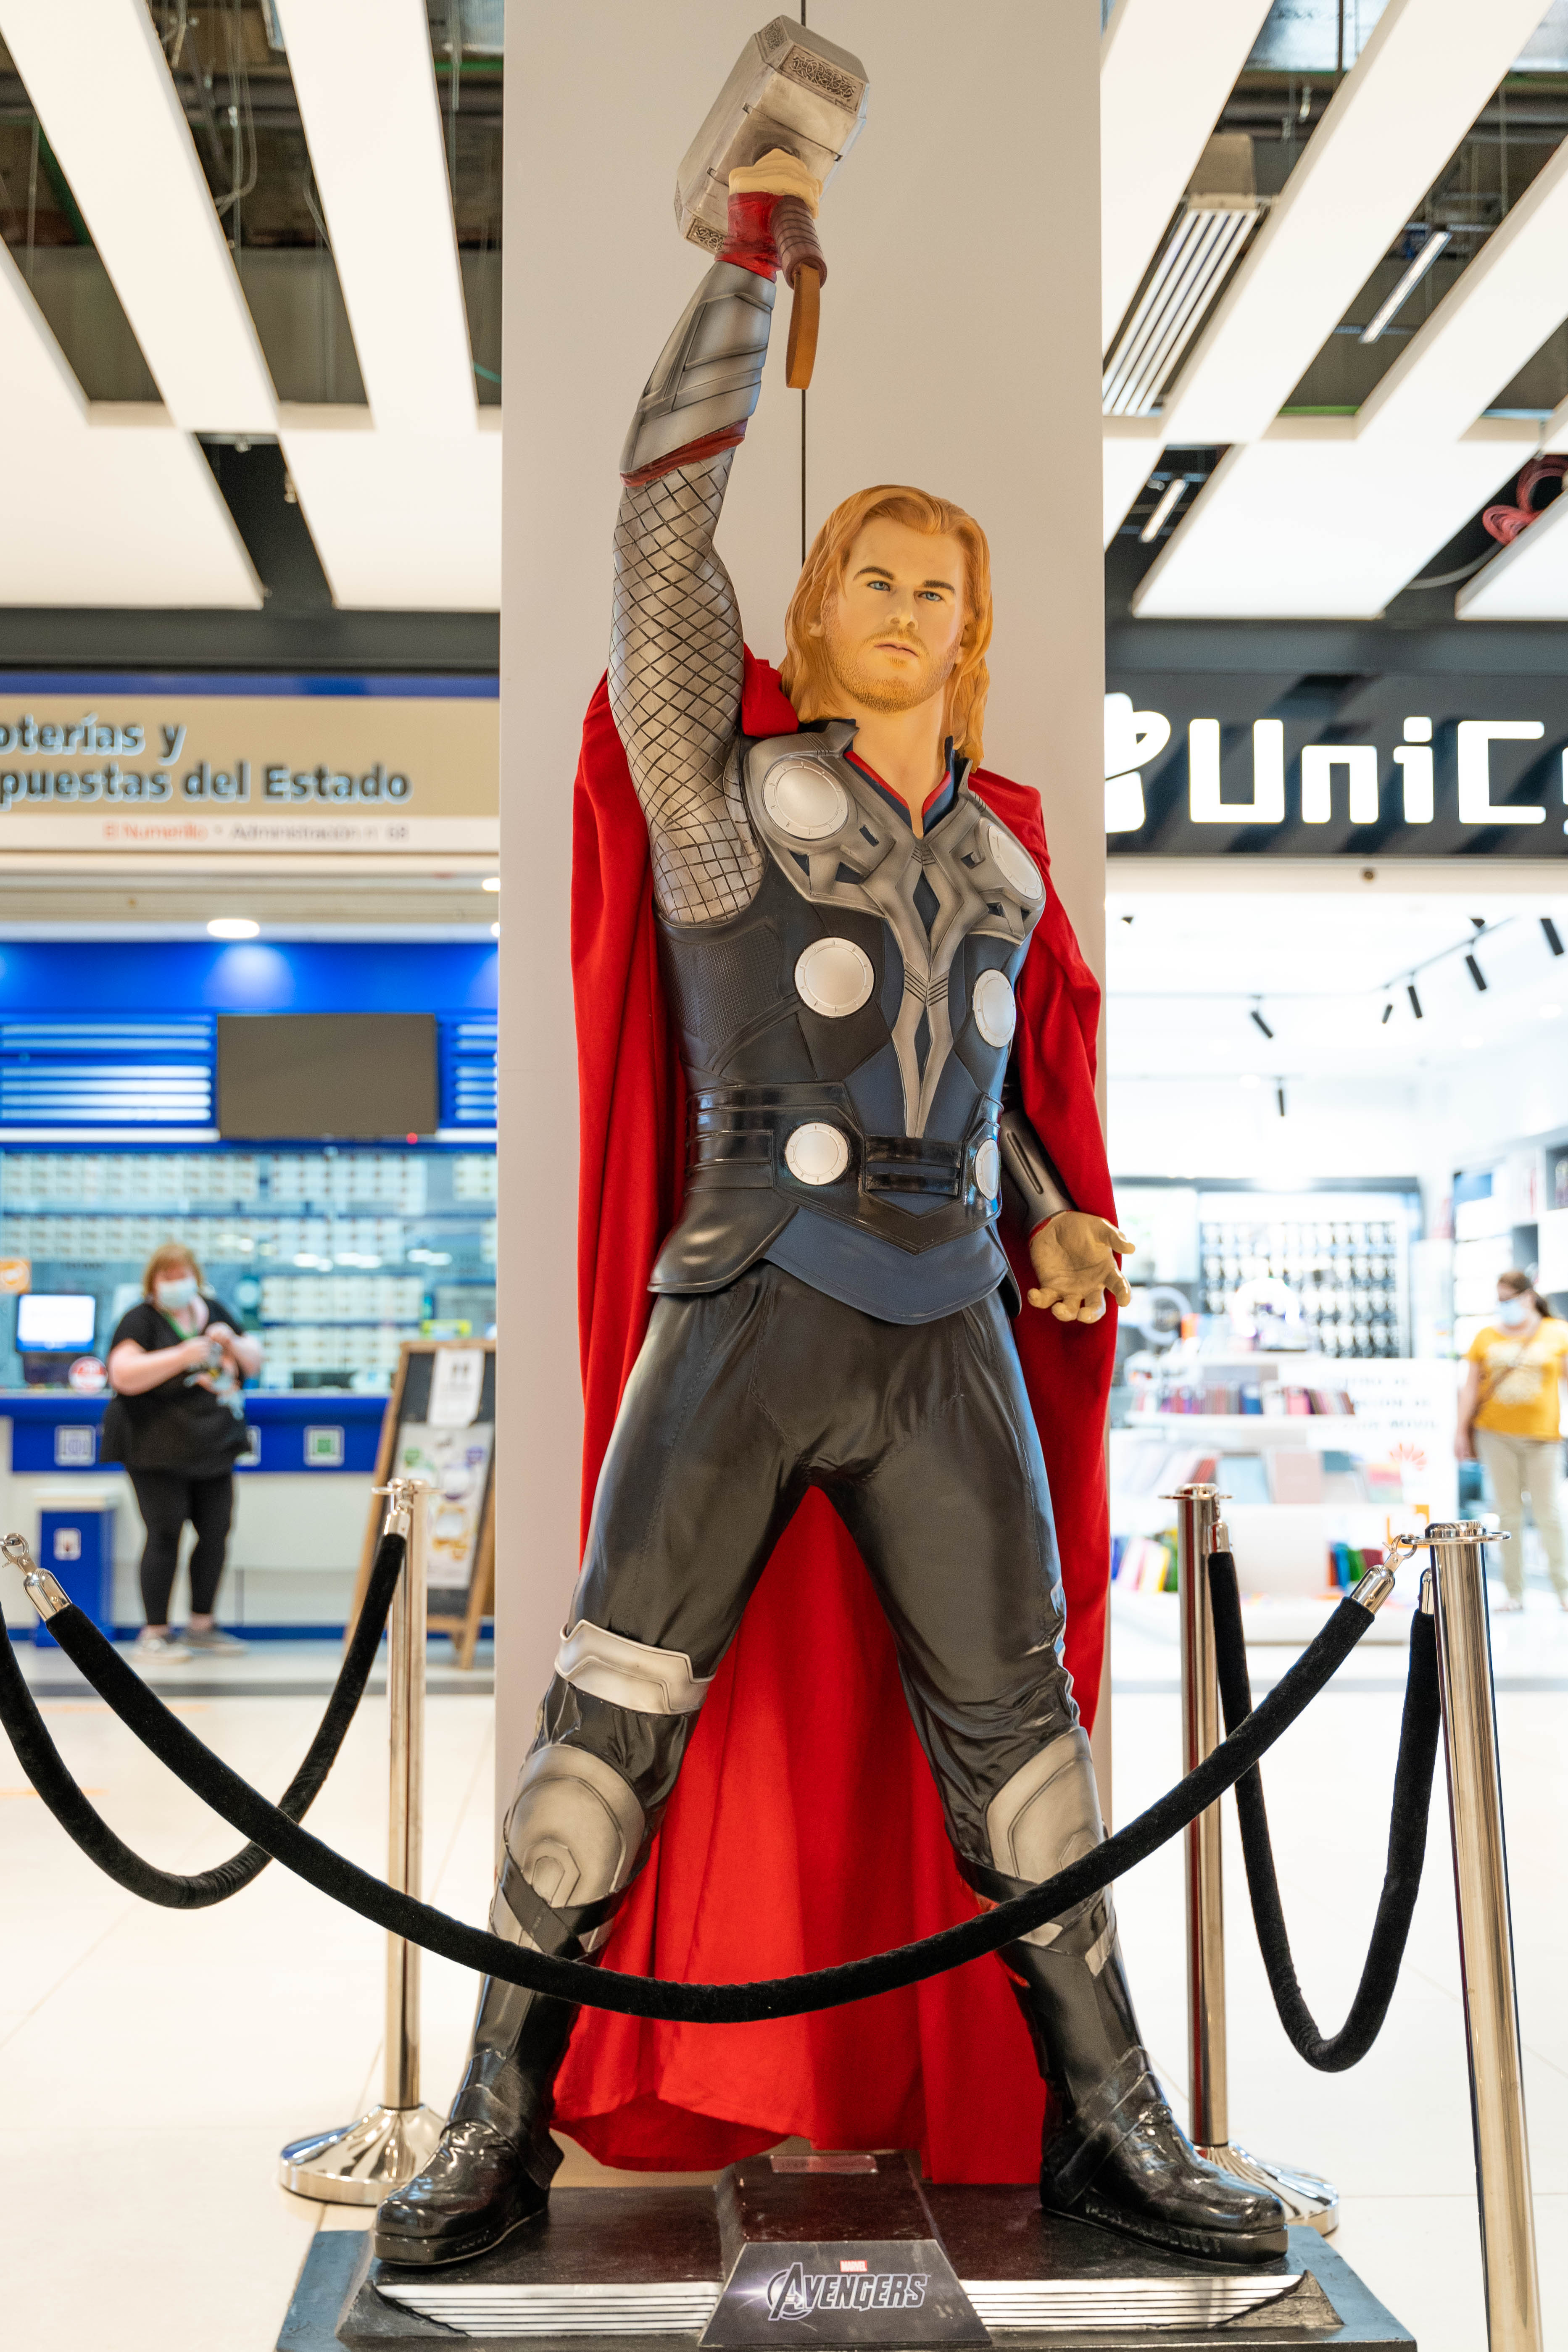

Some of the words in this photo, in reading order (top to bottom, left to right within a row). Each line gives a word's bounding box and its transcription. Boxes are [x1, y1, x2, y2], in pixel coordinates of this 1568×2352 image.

[158, 724, 187, 766] y
[181, 760, 251, 803] del
[261, 761, 414, 804] Estado
[1189, 716, 1568, 835] UniC
[841, 2260, 867, 2272] MARVEL
[767, 2262, 928, 2321] AVENGERS
